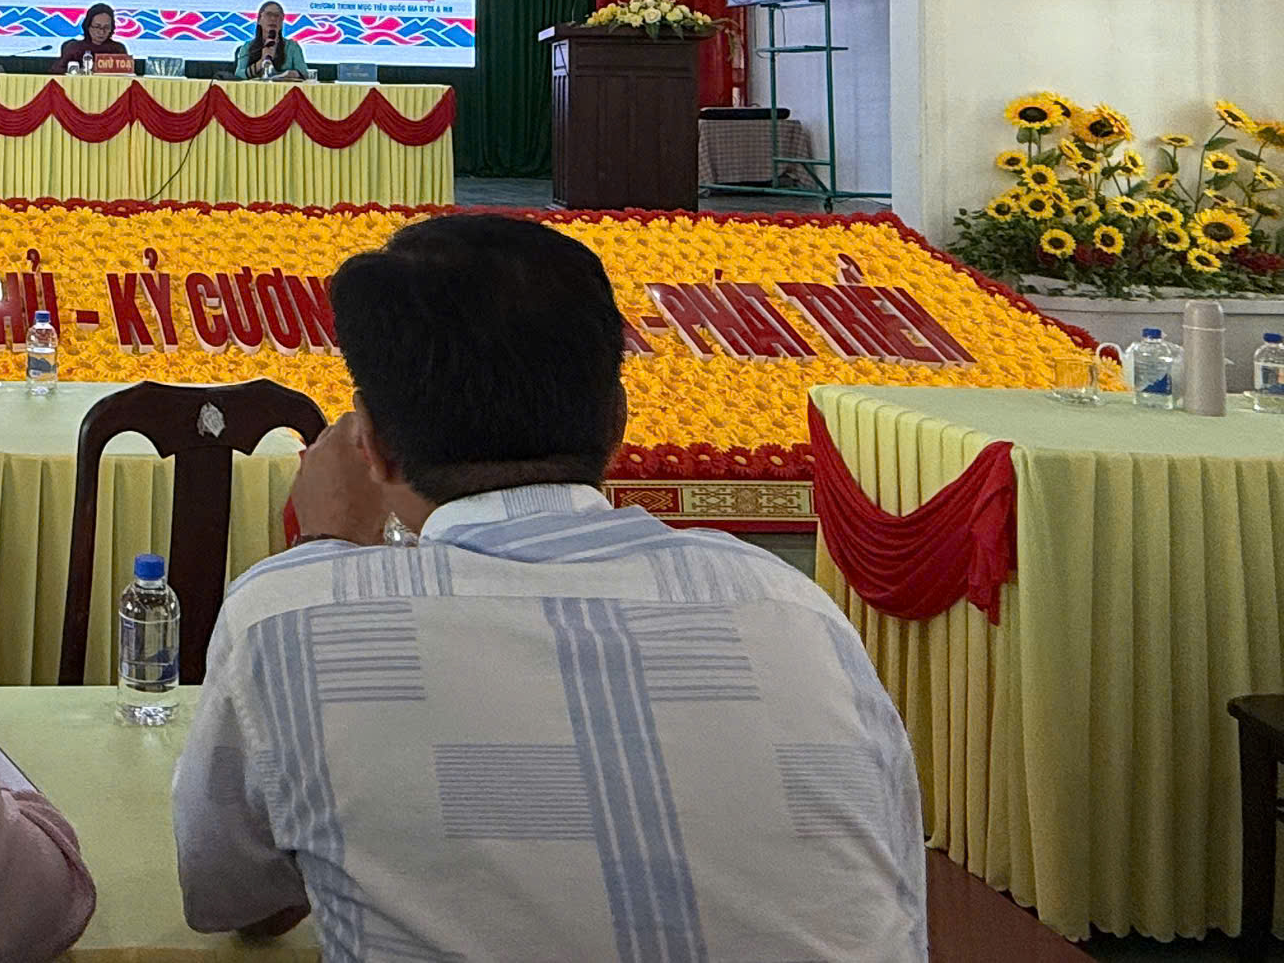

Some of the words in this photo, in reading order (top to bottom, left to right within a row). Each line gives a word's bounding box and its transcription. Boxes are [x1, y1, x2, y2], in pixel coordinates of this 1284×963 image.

[106, 249, 178, 353] KỶ
[185, 266, 340, 355] CƯƠN
[644, 268, 818, 361] PHÁT
[774, 253, 978, 367] TRIỂN
